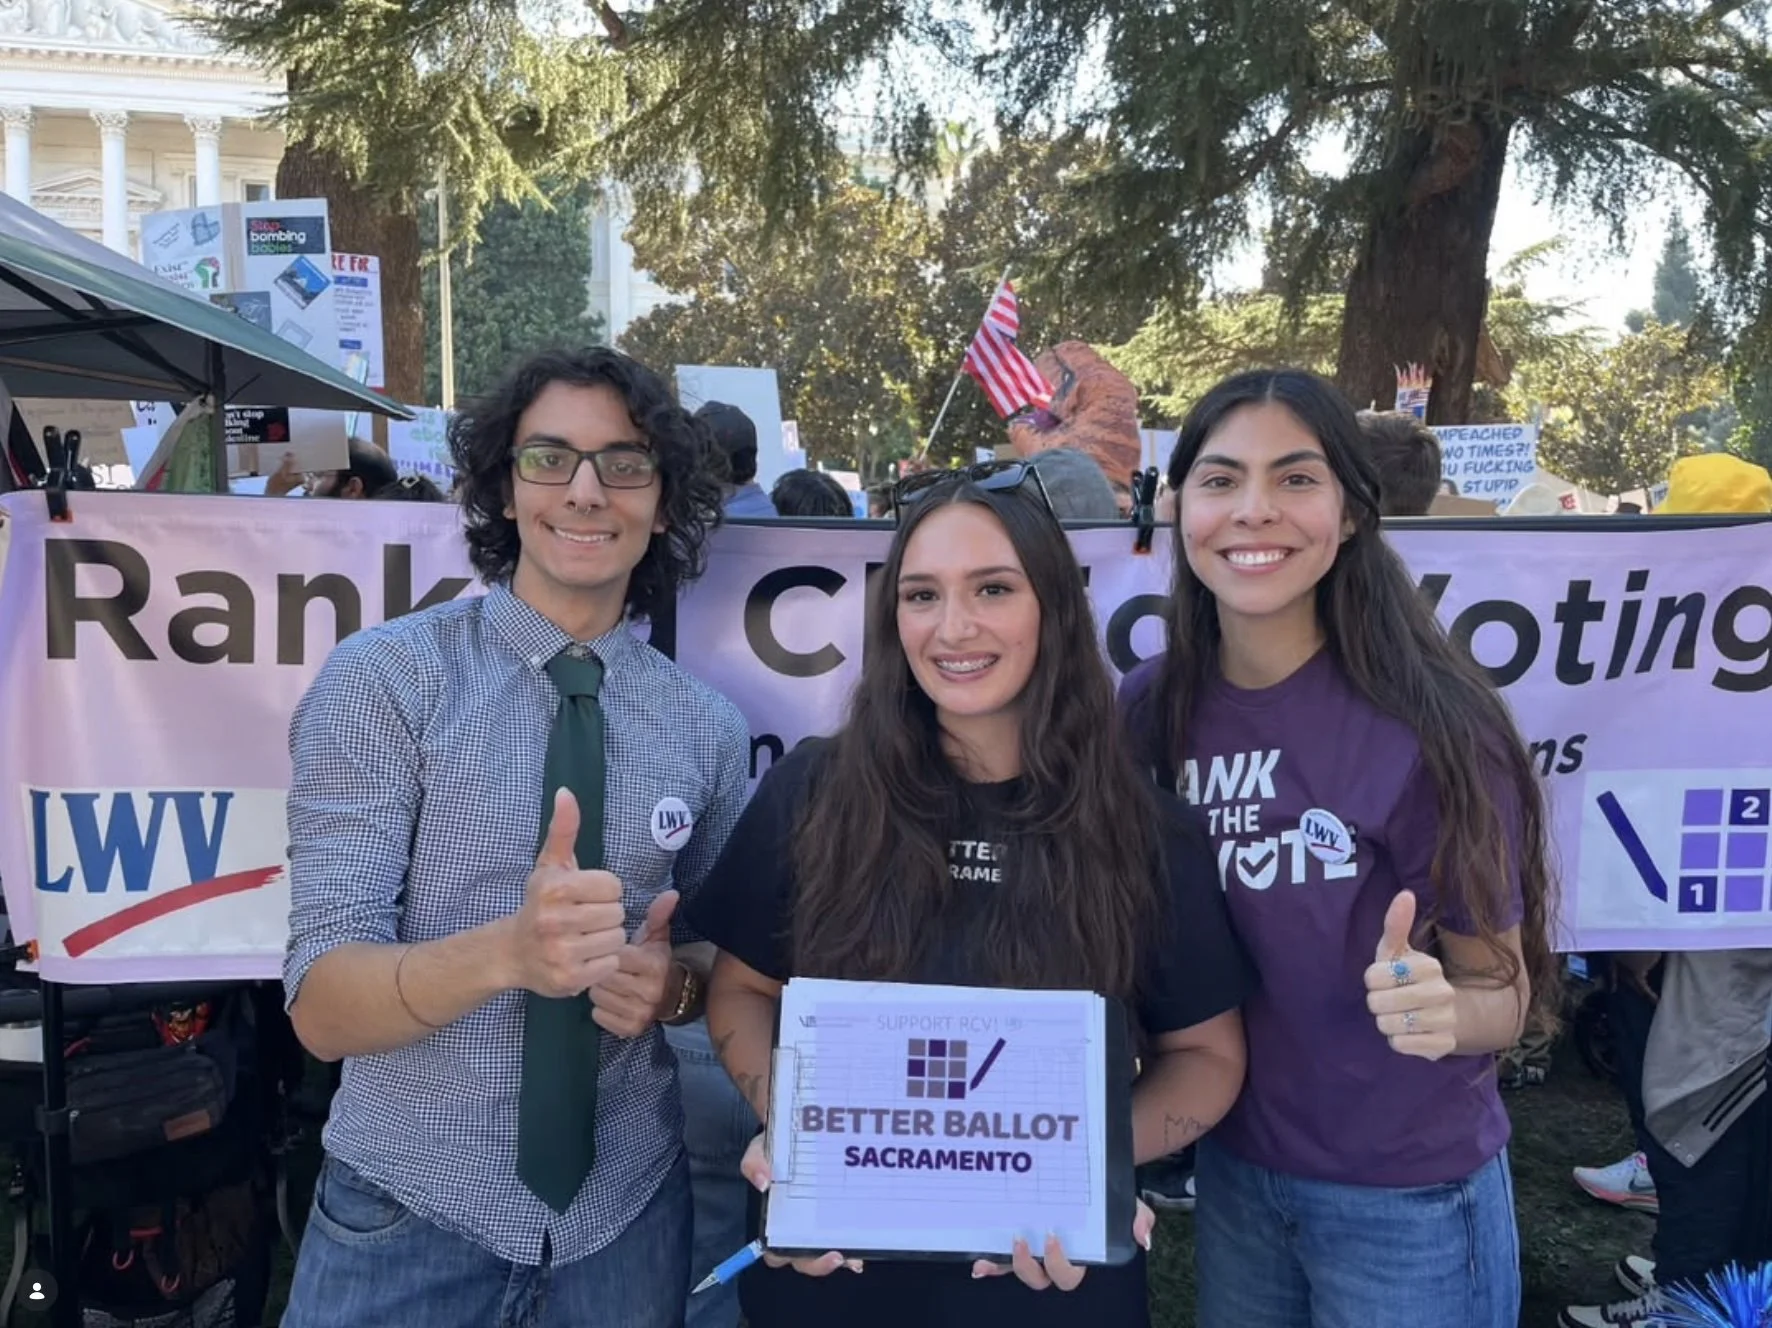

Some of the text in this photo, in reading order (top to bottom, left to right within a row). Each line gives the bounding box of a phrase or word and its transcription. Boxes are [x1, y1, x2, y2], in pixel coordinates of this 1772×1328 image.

[251, 220, 281, 232] Stop
[250, 230, 307, 244] bombing
[251, 242, 292, 253] babies
[1437, 427, 1524, 441] MPEACHED
[1443, 442, 1530, 460] WO TIMES?!
[1463, 460, 1534, 475] FUCKING
[1463, 479, 1519, 493] STUPID
[1176, 748, 1282, 806] ANK
[1741, 796, 1761, 819] 2
[658, 811, 688, 830] LWV
[1208, 804, 1261, 836] THE
[29, 789, 235, 894] LWV
[1305, 817, 1341, 848] LWV
[948, 864, 1002, 883] RAME
[1690, 883, 1704, 906] 1
[877, 1014, 999, 1033] SUPPORT RCV!
[801, 1105, 1079, 1142] BETTER BALLOT
[844, 1146, 1032, 1173] SACRAMENTO
